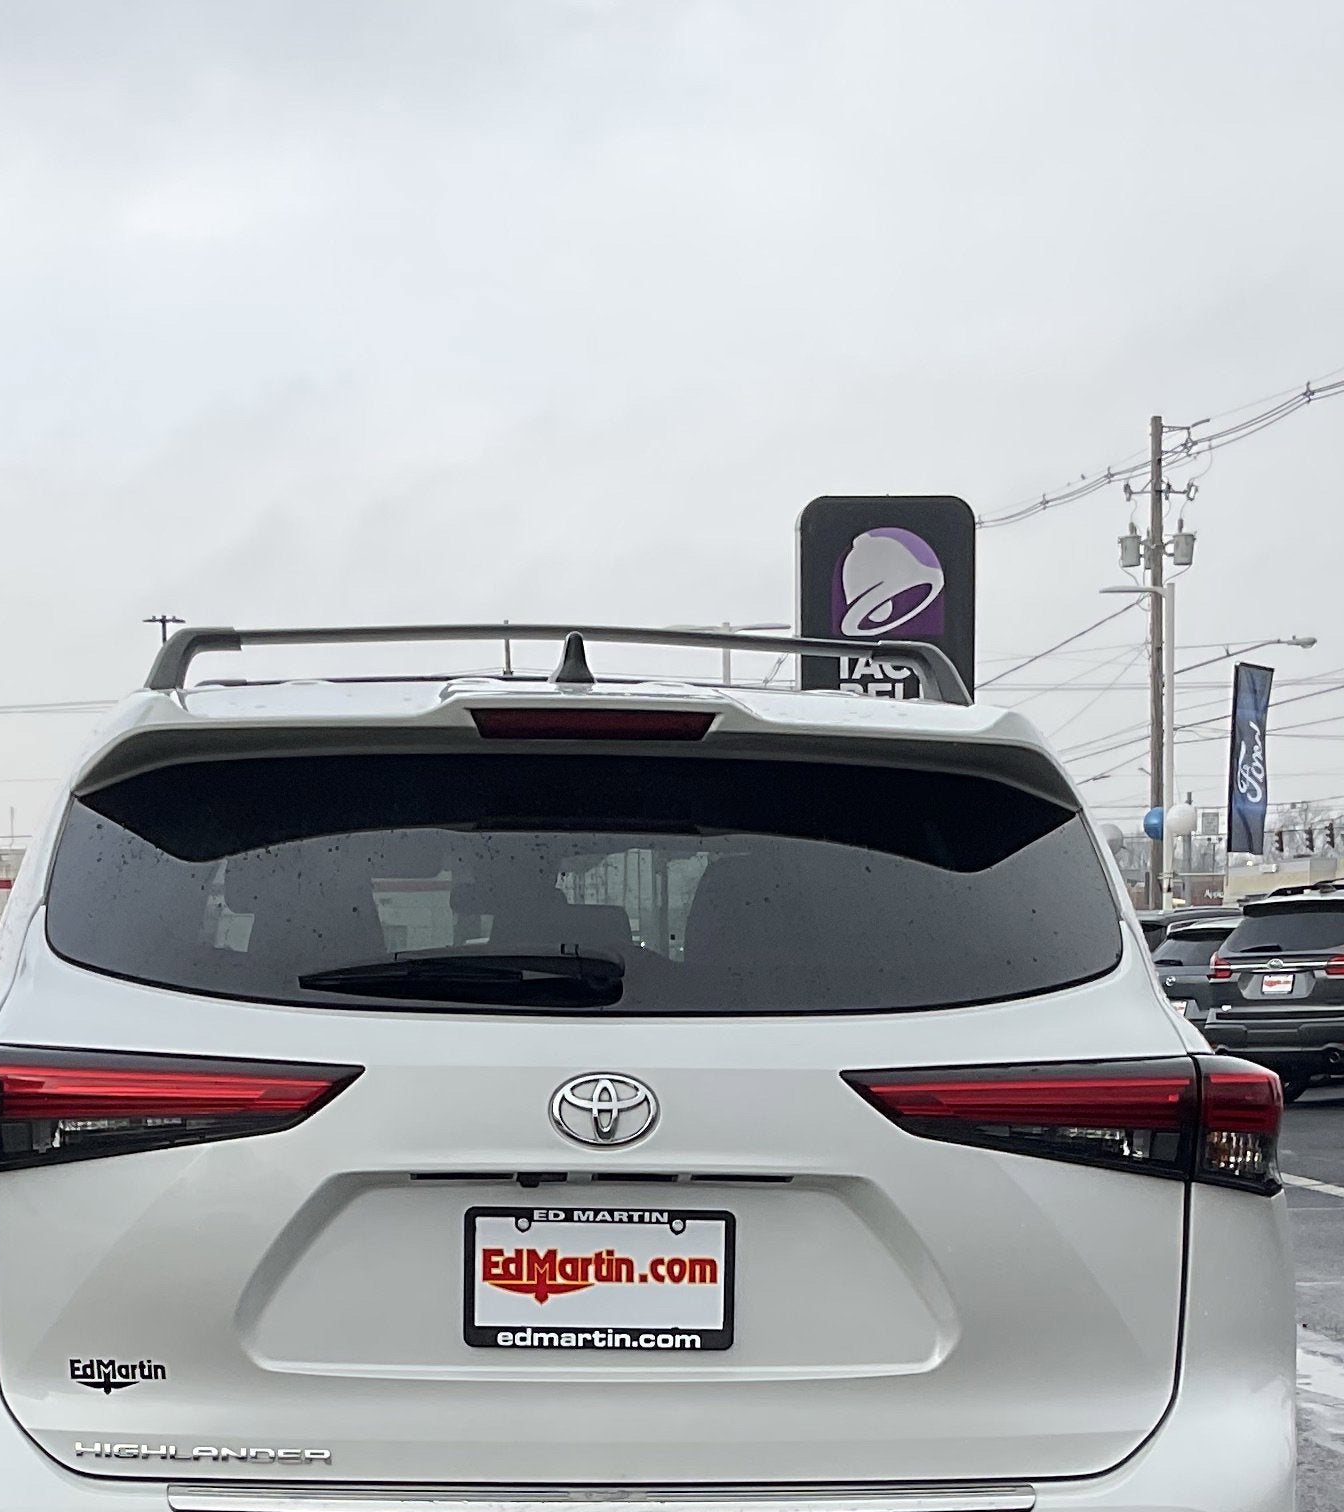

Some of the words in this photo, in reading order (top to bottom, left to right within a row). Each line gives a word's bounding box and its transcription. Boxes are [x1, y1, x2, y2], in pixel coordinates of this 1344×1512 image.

[838, 655, 912, 680] TAC
[1236, 720, 1265, 804] Ford
[533, 1210, 566, 1222] ED
[572, 1210, 670, 1223] MARTIN
[481, 1247, 718, 1287] EdMartin.com
[496, 1328, 702, 1350] edmartin.com
[68, 1358, 168, 1384] EdMartin
[74, 1441, 333, 1466] HIGHLANDER
